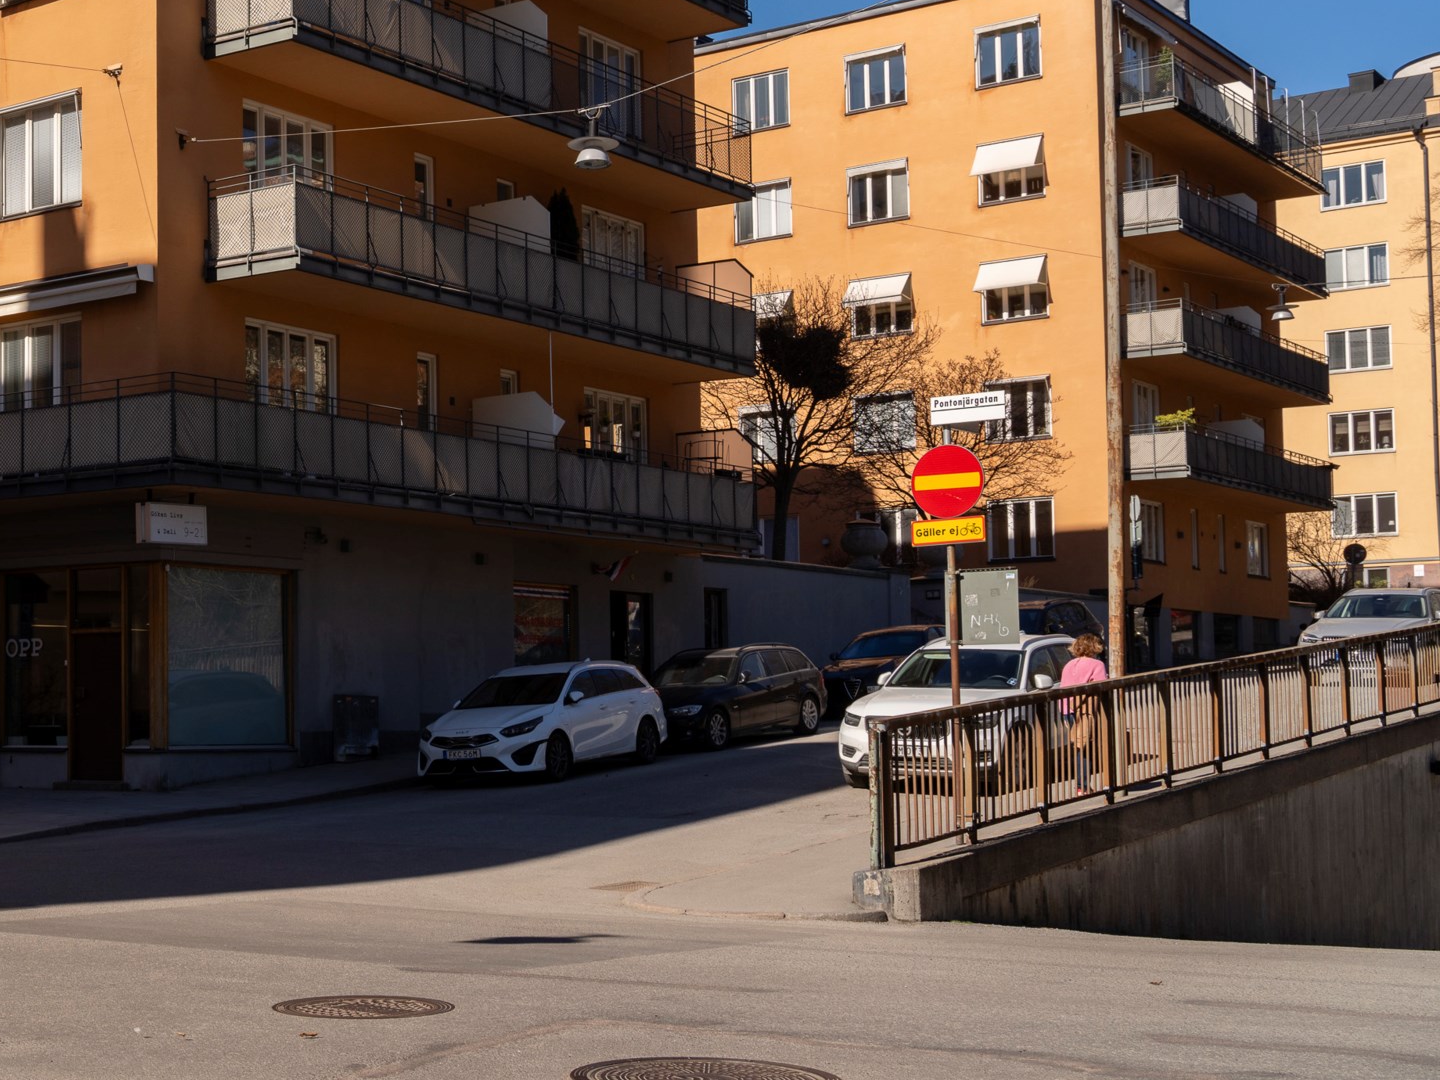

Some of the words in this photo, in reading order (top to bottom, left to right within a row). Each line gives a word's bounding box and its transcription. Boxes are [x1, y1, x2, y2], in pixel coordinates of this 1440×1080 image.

[934, 396, 999, 408] Pontonjärgatan
[916, 527, 946, 537] Gäller
[949, 526, 959, 536] ej
[5, 638, 44, 658] OPP
